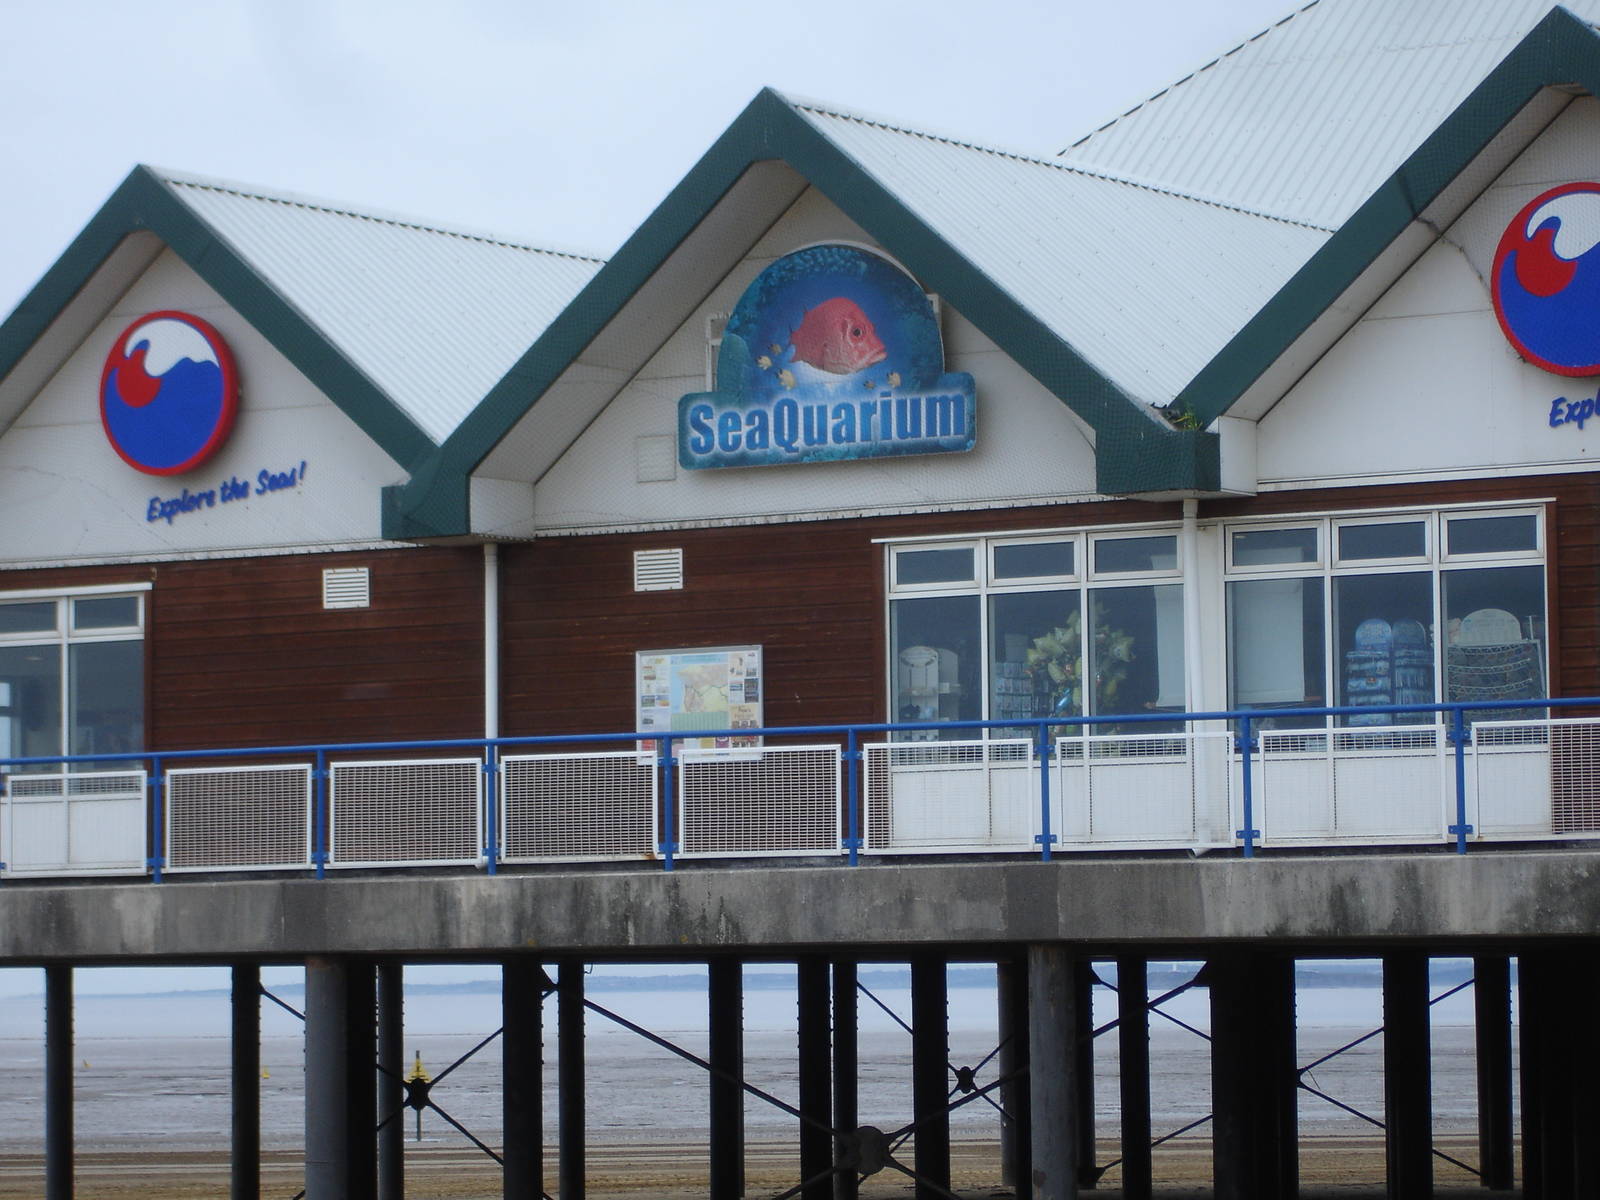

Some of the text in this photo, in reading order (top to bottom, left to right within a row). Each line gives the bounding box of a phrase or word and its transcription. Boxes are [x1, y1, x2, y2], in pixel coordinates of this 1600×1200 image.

[690, 391, 965, 455] SeaQuarium
[147, 489, 216, 525] Explore
[220, 476, 249, 503] the
